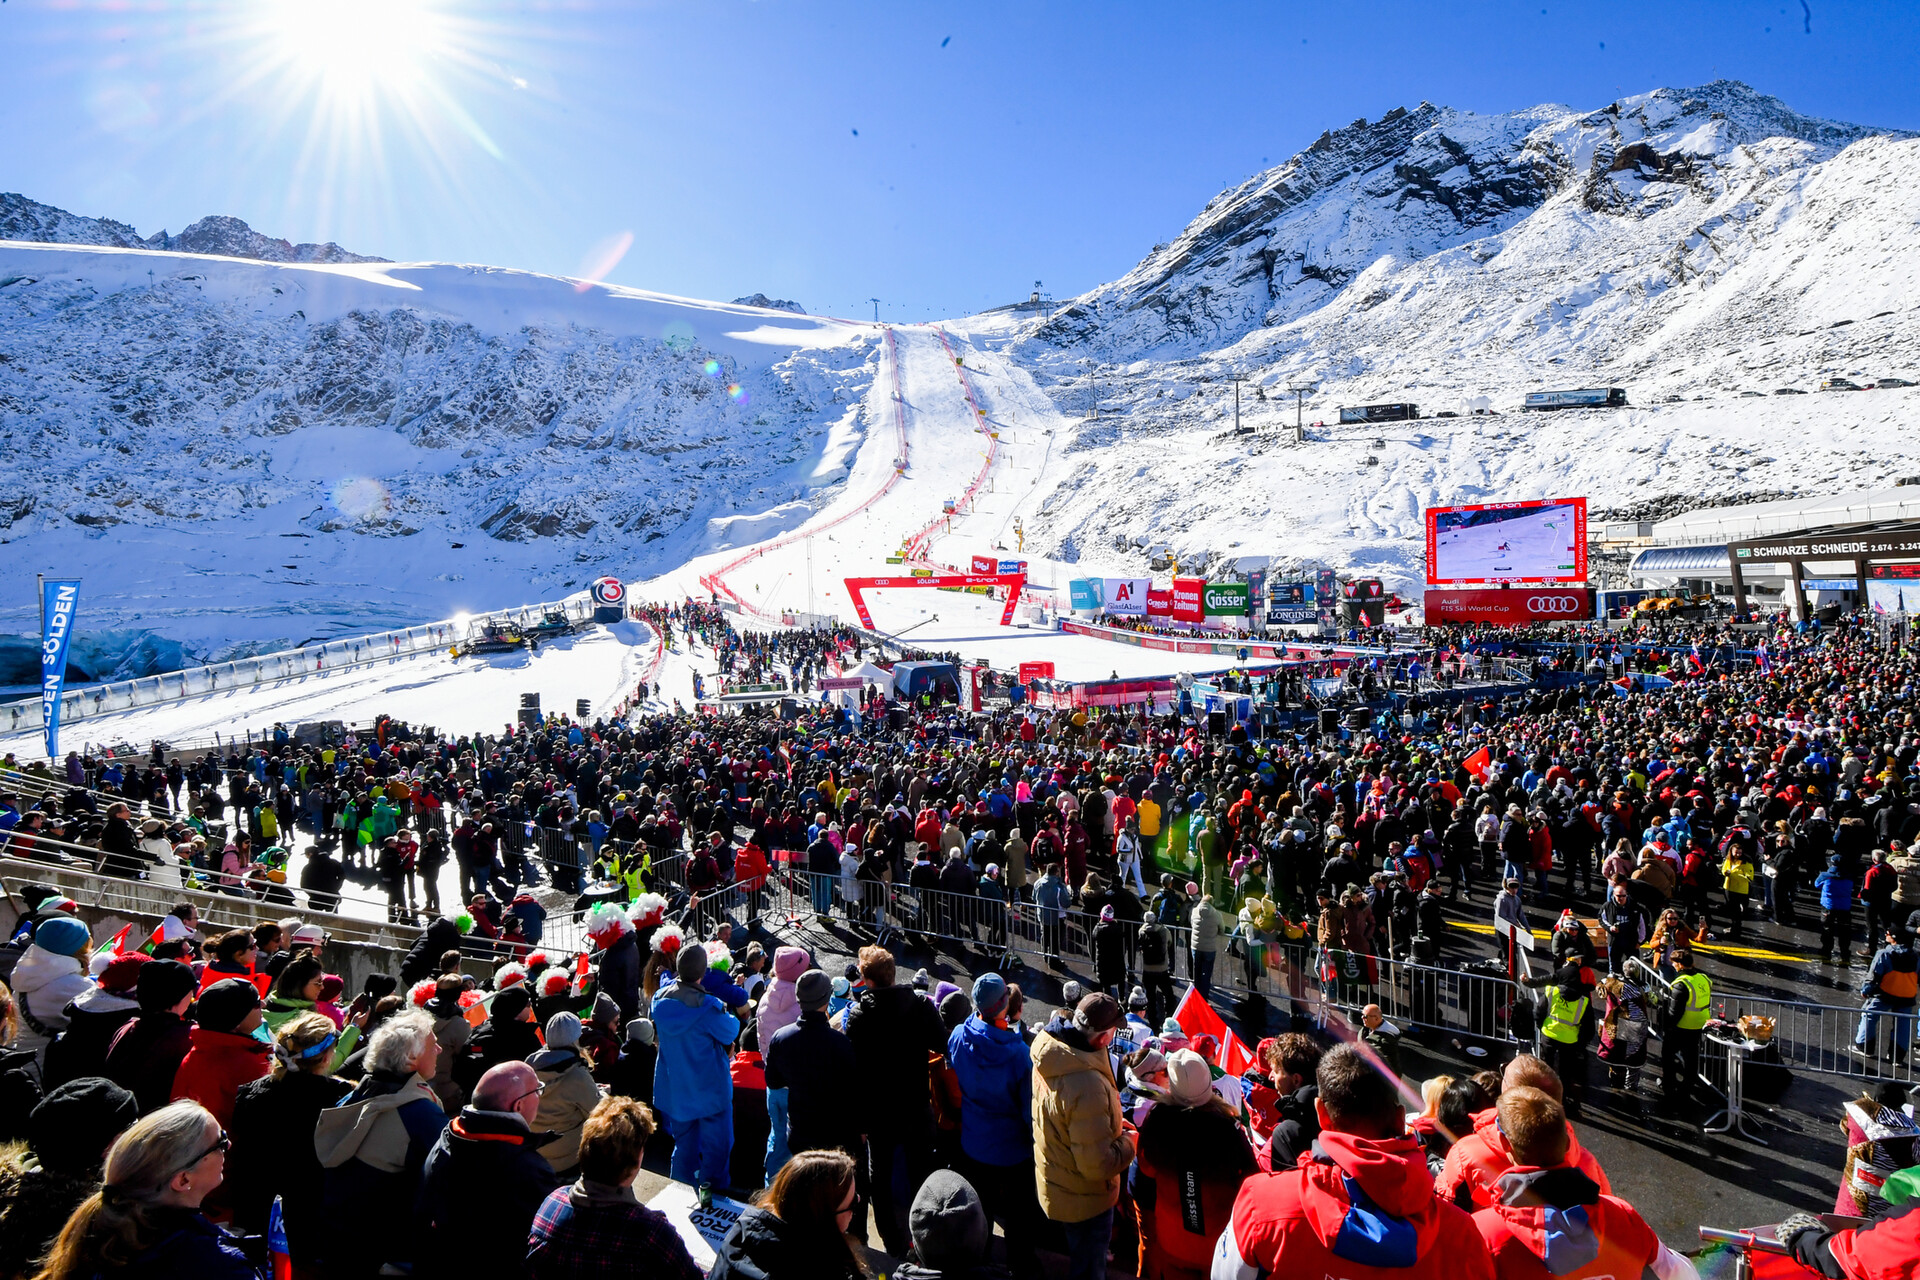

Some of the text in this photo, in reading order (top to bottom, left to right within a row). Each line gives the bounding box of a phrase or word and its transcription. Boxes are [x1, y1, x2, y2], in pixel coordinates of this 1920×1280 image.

[1483, 502, 1522, 510] e-tron
[1753, 545, 1809, 557] SCHWARZE
[1811, 542, 1868, 554] SCHNEIDE
[1870, 544, 1892, 552] 2.674
[1116, 581, 1134, 601] A1
[1173, 590, 1199, 601] Kronen
[1173, 602, 1199, 613] Zeitung
[1205, 590, 1246, 610] Gösser
[1270, 611, 1317, 620] LONGINES
[1494, 605, 1510, 613] Cup
[42, 585, 76, 665] SÖLDEN
[1343, 952, 1360, 978] Göss
[1186, 1171, 1195, 1198] team
[690, 1214, 733, 1234] RCO
[700, 1230, 725, 1241] ANCLUB
